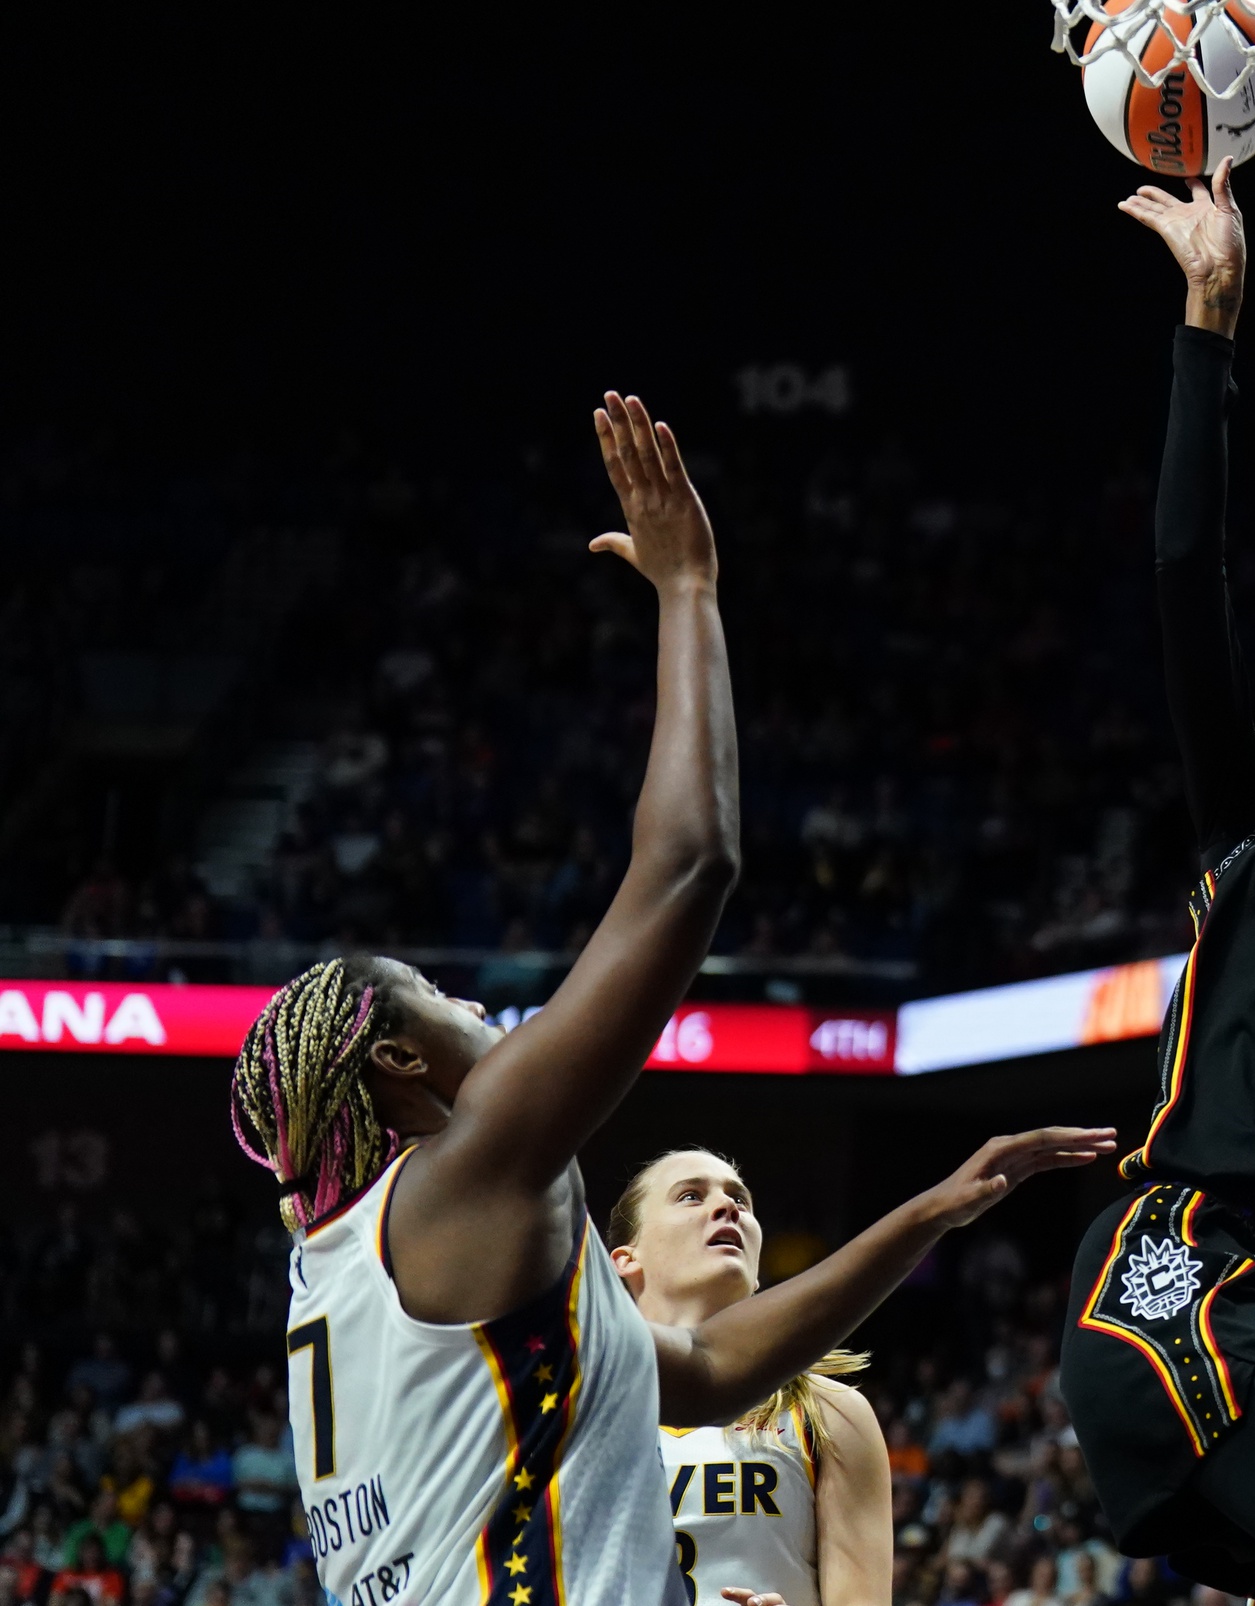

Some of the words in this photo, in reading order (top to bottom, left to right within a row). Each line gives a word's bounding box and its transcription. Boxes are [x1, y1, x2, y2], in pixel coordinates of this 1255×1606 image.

[1147, 70, 1186, 174] Wilson
[737, 363, 850, 413] 104
[0, 990, 166, 1046] ANA
[286, 1313, 337, 1483] 7
[352, 1551, 415, 1606] AT&T
